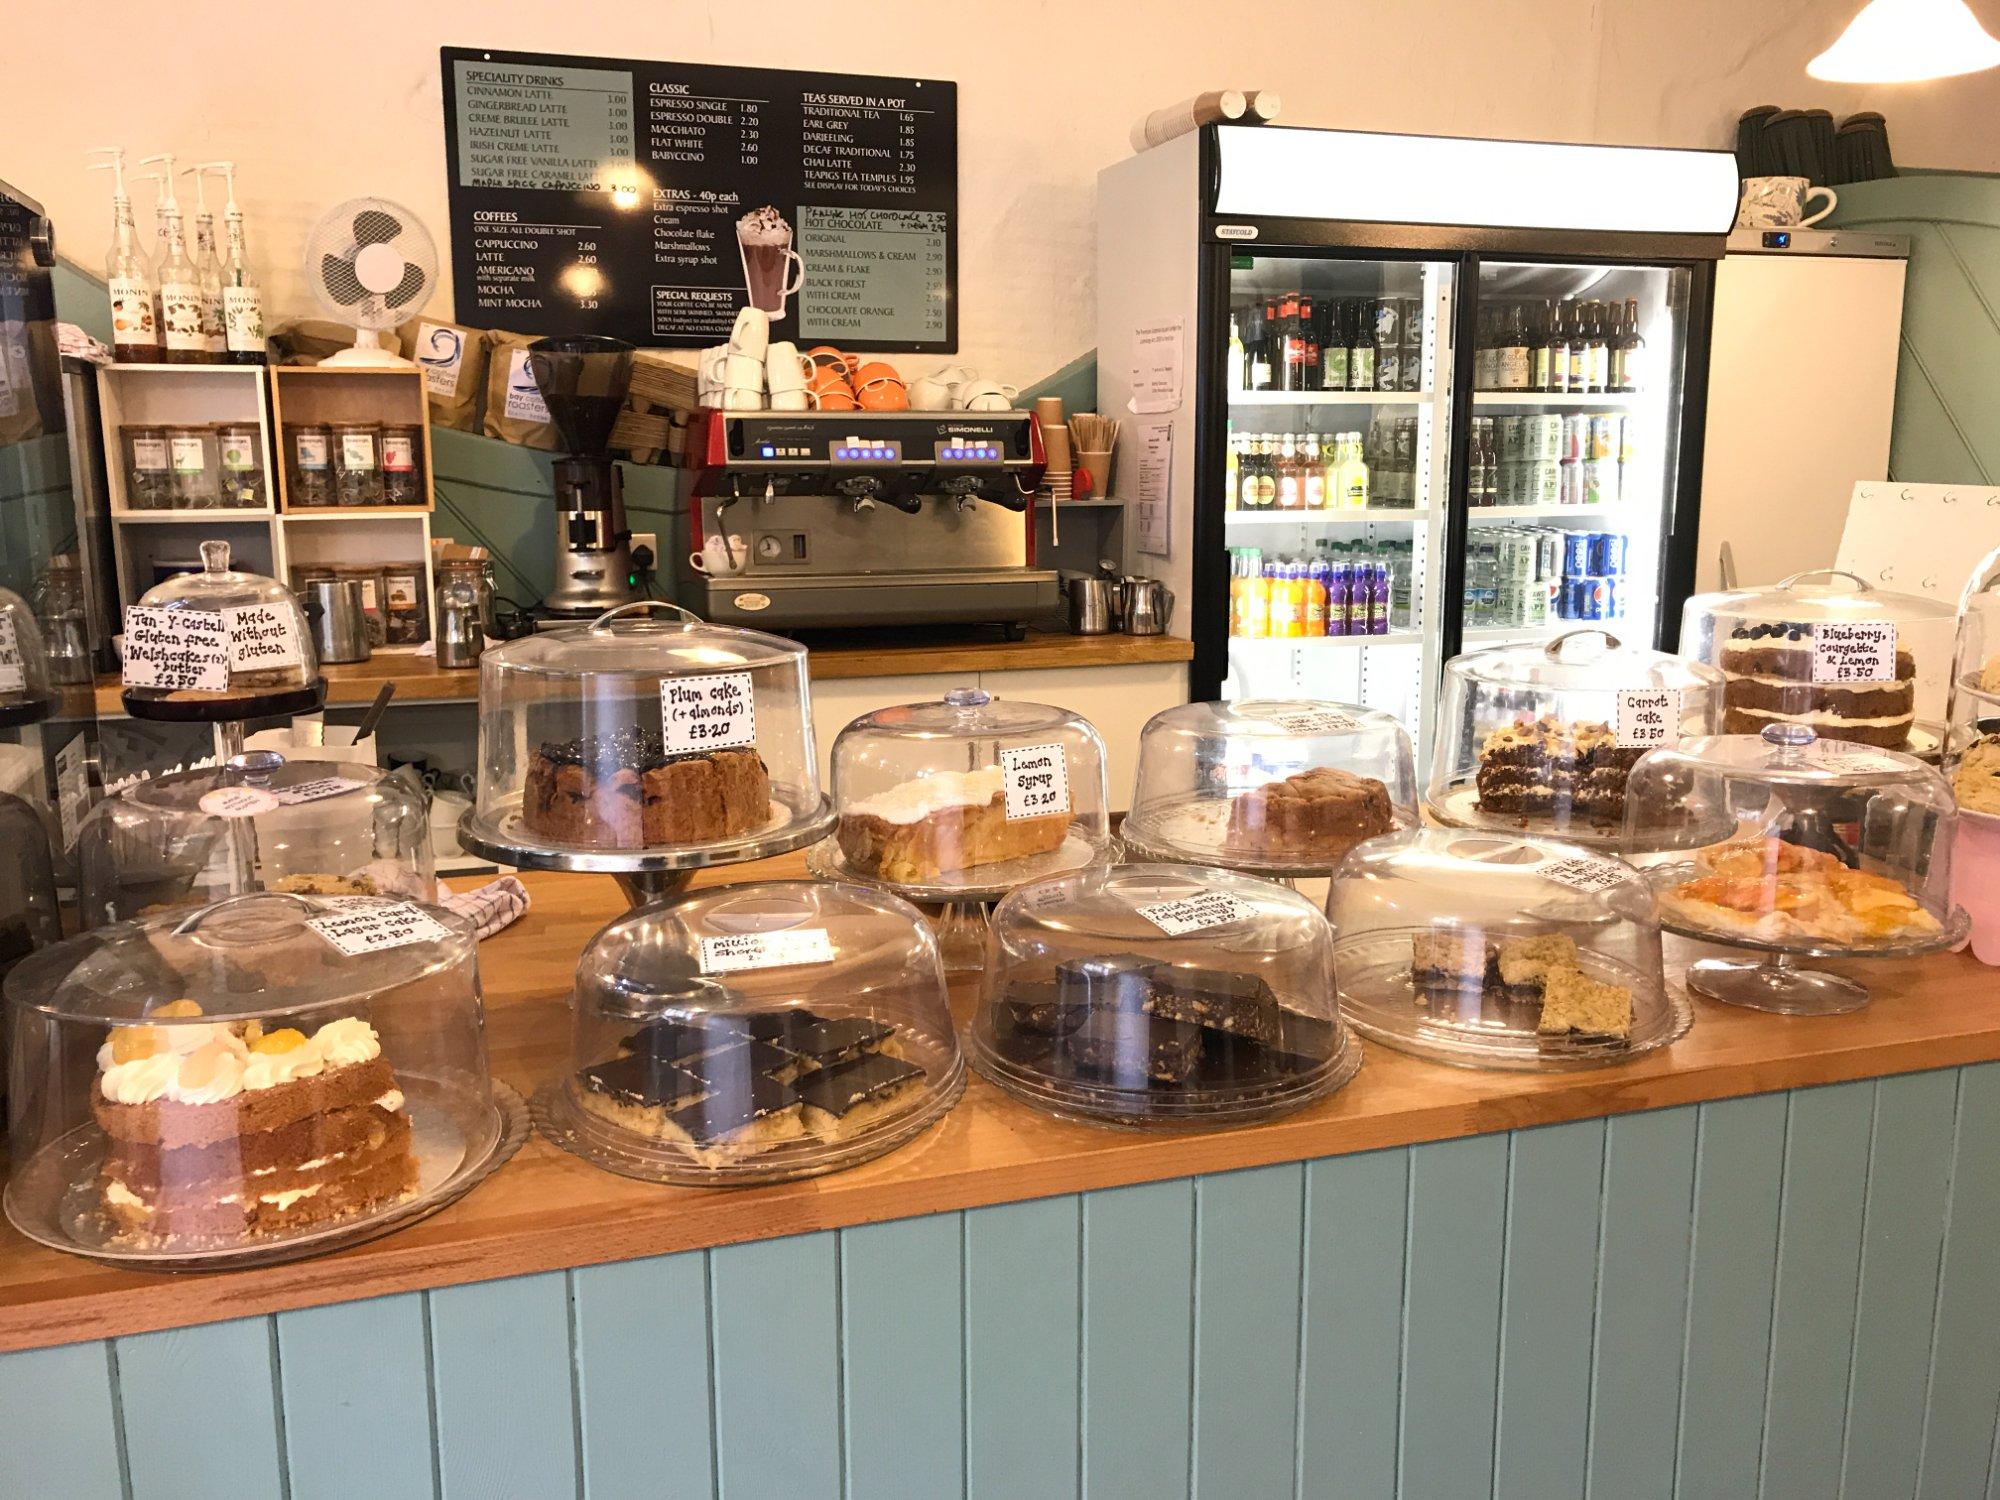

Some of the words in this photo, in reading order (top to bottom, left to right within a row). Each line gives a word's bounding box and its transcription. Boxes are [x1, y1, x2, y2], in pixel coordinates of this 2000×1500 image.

[466, 71, 523, 84] SPECIALITY
[526, 76, 564, 86] DRINKS
[467, 87, 522, 97] CINNAMON
[524, 90, 553, 99] LATTE
[650, 83, 690, 94] CLASSIC
[468, 100, 536, 111] GINGERBREAD
[540, 104, 567, 113] LATTE
[650, 98, 694, 109] ESPRESSO
[696, 101, 727, 111] SINGLE
[740, 104, 757, 113] 1.80
[803, 93, 826, 103] TEAS
[829, 94, 863, 105] SERVED
[866, 97, 876, 106] IN
[878, 98, 885, 107] A
[888, 99, 905, 108] POT
[650, 112, 694, 122] ESPRESSO
[697, 114, 733, 124] DOUBLE
[740, 117, 758, 126] 2.20
[803, 107, 861, 118] TRADITIONAL
[863, 111, 880, 119] TEA
[900, 113, 914, 121] 1.65
[469, 114, 499, 123] CREME
[504, 116, 538, 126] BRULEE
[541, 118, 570, 127] LATTE
[651, 125, 706, 135] MACCHIATO
[740, 130, 758, 139] 2.30
[803, 120, 824, 128] EARL
[827, 121, 848, 129] GREY
[900, 126, 914, 134] 1.85
[469, 128, 520, 138] HAZELNUT
[524, 131, 552, 139] LATTE
[803, 132, 854, 143] DARJEELING
[900, 138, 914, 147] 1.85
[470, 141, 494, 150] IRISH
[497, 142, 528, 152] CREME
[532, 144, 559, 153] LATTE
[652, 138, 671, 146] FLAT
[674, 140, 703, 148] WHITE
[741, 143, 758, 152] 2.60
[652, 151, 704, 162] BABYCCINO
[741, 156, 758, 164] 1.00
[803, 145, 831, 154] DECAF
[834, 147, 891, 158] TRADITIONAL
[900, 151, 914, 159] 1.75
[471, 155, 503, 164] SUGAR
[506, 156, 528, 165] FREE
[531, 157, 568, 166] VANILLA
[803, 158, 825, 167] CHAI
[827, 159, 852, 168] LATTE
[899, 163, 915, 172] 2.30
[471, 168, 504, 177] SUGAR
[507, 169, 529, 177] FREE
[532, 170, 575, 179] CARAMEL
[804, 171, 839, 180] TEAPIGS
[842, 172, 858, 181] TEA
[860, 173, 896, 183] TEMPLES
[900, 176, 914, 184] 1.95
[653, 190, 690, 199] EXTRAS
[699, 191, 716, 202] 40p
[719, 193, 738, 201] each
[654, 203, 673, 212] Extra
[676, 205, 710, 215] espresso
[711, 205, 728, 213] shot
[474, 211, 518, 222] COFFEES
[654, 216, 680, 224] Cream
[805, 219, 824, 227] HOT
[827, 219, 882, 230] CHOCOLATE
[655, 228, 694, 238] Chocolate
[696, 229, 715, 239] flake
[805, 234, 846, 243] ORIGINAL
[475, 239, 538, 249] CAPPUCCINO
[578, 242, 596, 251] 2.60
[655, 242, 710, 251] Marshmallows
[476, 253, 504, 261] LATTE
[578, 255, 597, 264] 2.60
[655, 254, 676, 263] Extra
[677, 256, 699, 266] syrup
[701, 256, 717, 264] shot
[806, 249, 876, 260] MARSHMALLOWS
[887, 252, 916, 260] CREAM
[476, 266, 534, 275] AMERICANO
[806, 264, 835, 272] CREAM
[838, 265, 843, 273] &
[846, 265, 870, 273] FLAKE
[806, 279, 833, 287] BLACK
[835, 280, 866, 288] FOREST
[478, 286, 514, 294] MOCHA
[656, 291, 689, 299] SPECIAL
[691, 292, 732, 302] REQUESTS
[478, 299, 502, 307] MINT
[506, 300, 542, 308] MOCHA
[807, 306, 857, 315] CHOCOLATE
[860, 308, 894, 316] ORANGE
[807, 319, 829, 327] WITH
[832, 319, 860, 327] CREAM
[237, 609, 275, 625] Made
[134, 630, 180, 645] Gluten
[184, 635, 219, 647] free
[239, 644, 285, 660] gluten
[1820, 643, 1877, 655] Courgette
[1827, 655, 1836, 665] &
[1840, 656, 1879, 665] Lemon
[162, 663, 206, 675] butter
[1838, 668, 1873, 678] £3.50
[670, 686, 702, 704] Plum
[710, 682, 741, 700] cake
[1628, 695, 1668, 708] Carrot
[1636, 711, 1662, 724] cake
[689, 722, 730, 739] £3.20
[1013, 757, 1052, 771] Lemon
[1018, 774, 1052, 790] Syrup
[1148, 902, 1192, 914] Polish
[320, 916, 376, 928] Lemon
[378, 907, 417, 917] Curd
[331, 924, 381, 937] Layer
